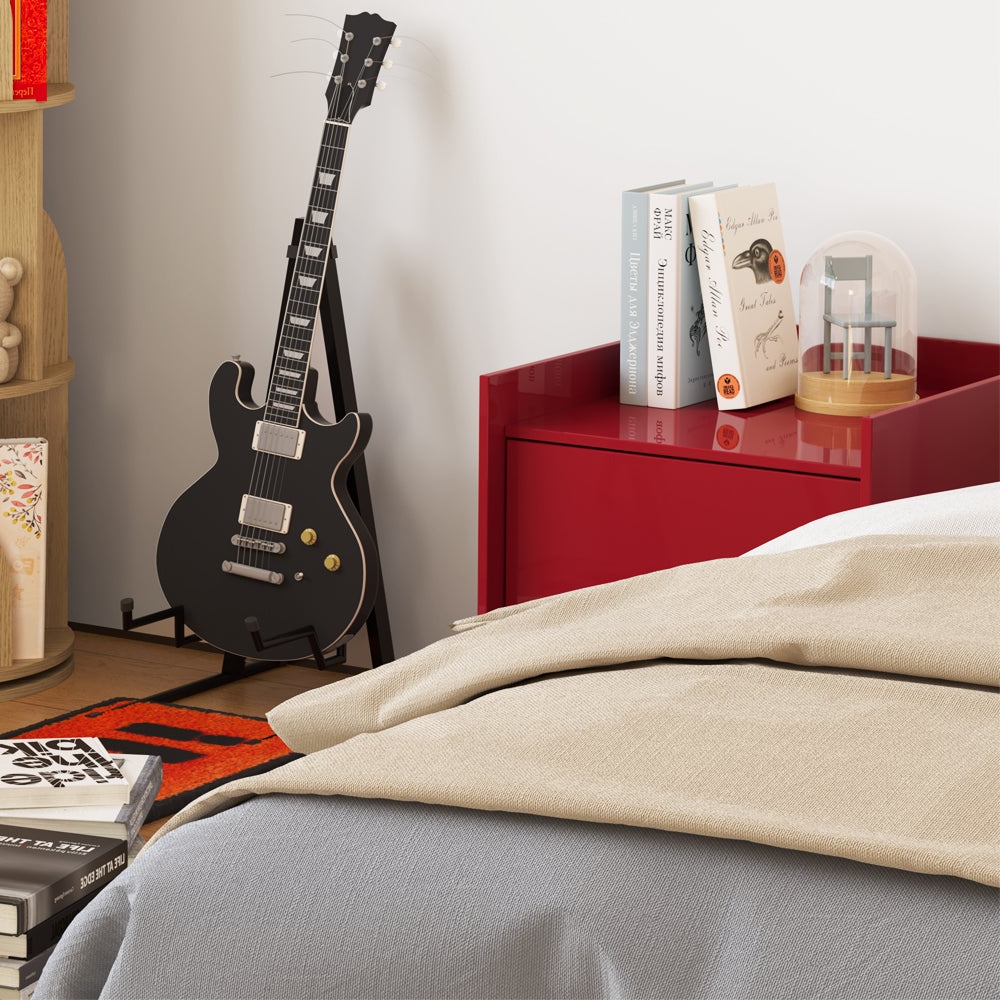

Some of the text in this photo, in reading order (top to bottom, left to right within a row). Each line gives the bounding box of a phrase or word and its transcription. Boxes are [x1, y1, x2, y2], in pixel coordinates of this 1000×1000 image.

[653, 207, 662, 240] ФРАЙ
[664, 208, 673, 241] МАКС
[726, 216, 745, 235] Edgar
[628, 252, 640, 291] Цветы
[699, 229, 729, 349] Edgar Allan Poe
[628, 295, 638, 316] для
[654, 258, 667, 396] Энциклопедия мифов
[628, 321, 640, 394] Элджернона
